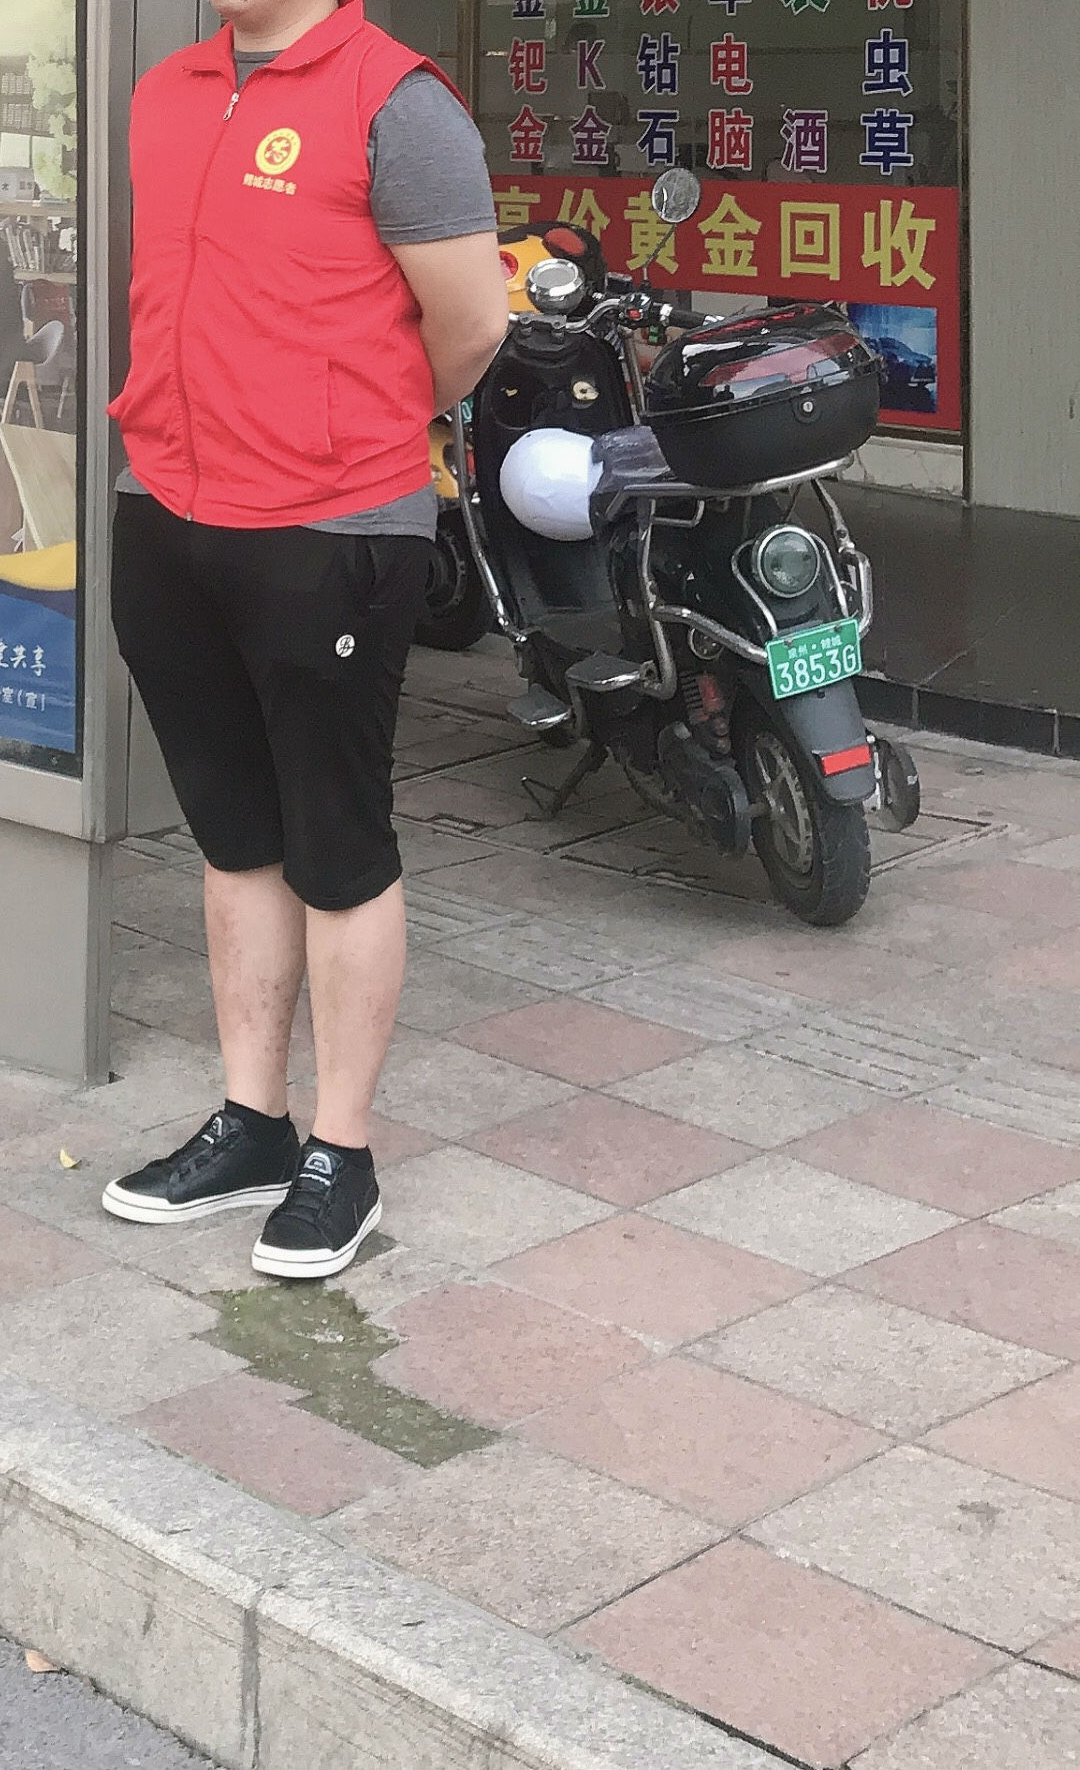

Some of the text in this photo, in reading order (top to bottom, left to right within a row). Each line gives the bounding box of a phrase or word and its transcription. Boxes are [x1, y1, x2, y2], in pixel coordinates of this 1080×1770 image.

[509, 38, 548, 164] 钯金
[571, 38, 613, 166] K金
[637, 34, 680, 166] 钻石
[707, 36, 754, 172] 电脑
[782, 108, 829, 174] 酒
[859, 28, 915, 175] 虫草
[776, 644, 857, 693] 3853G
